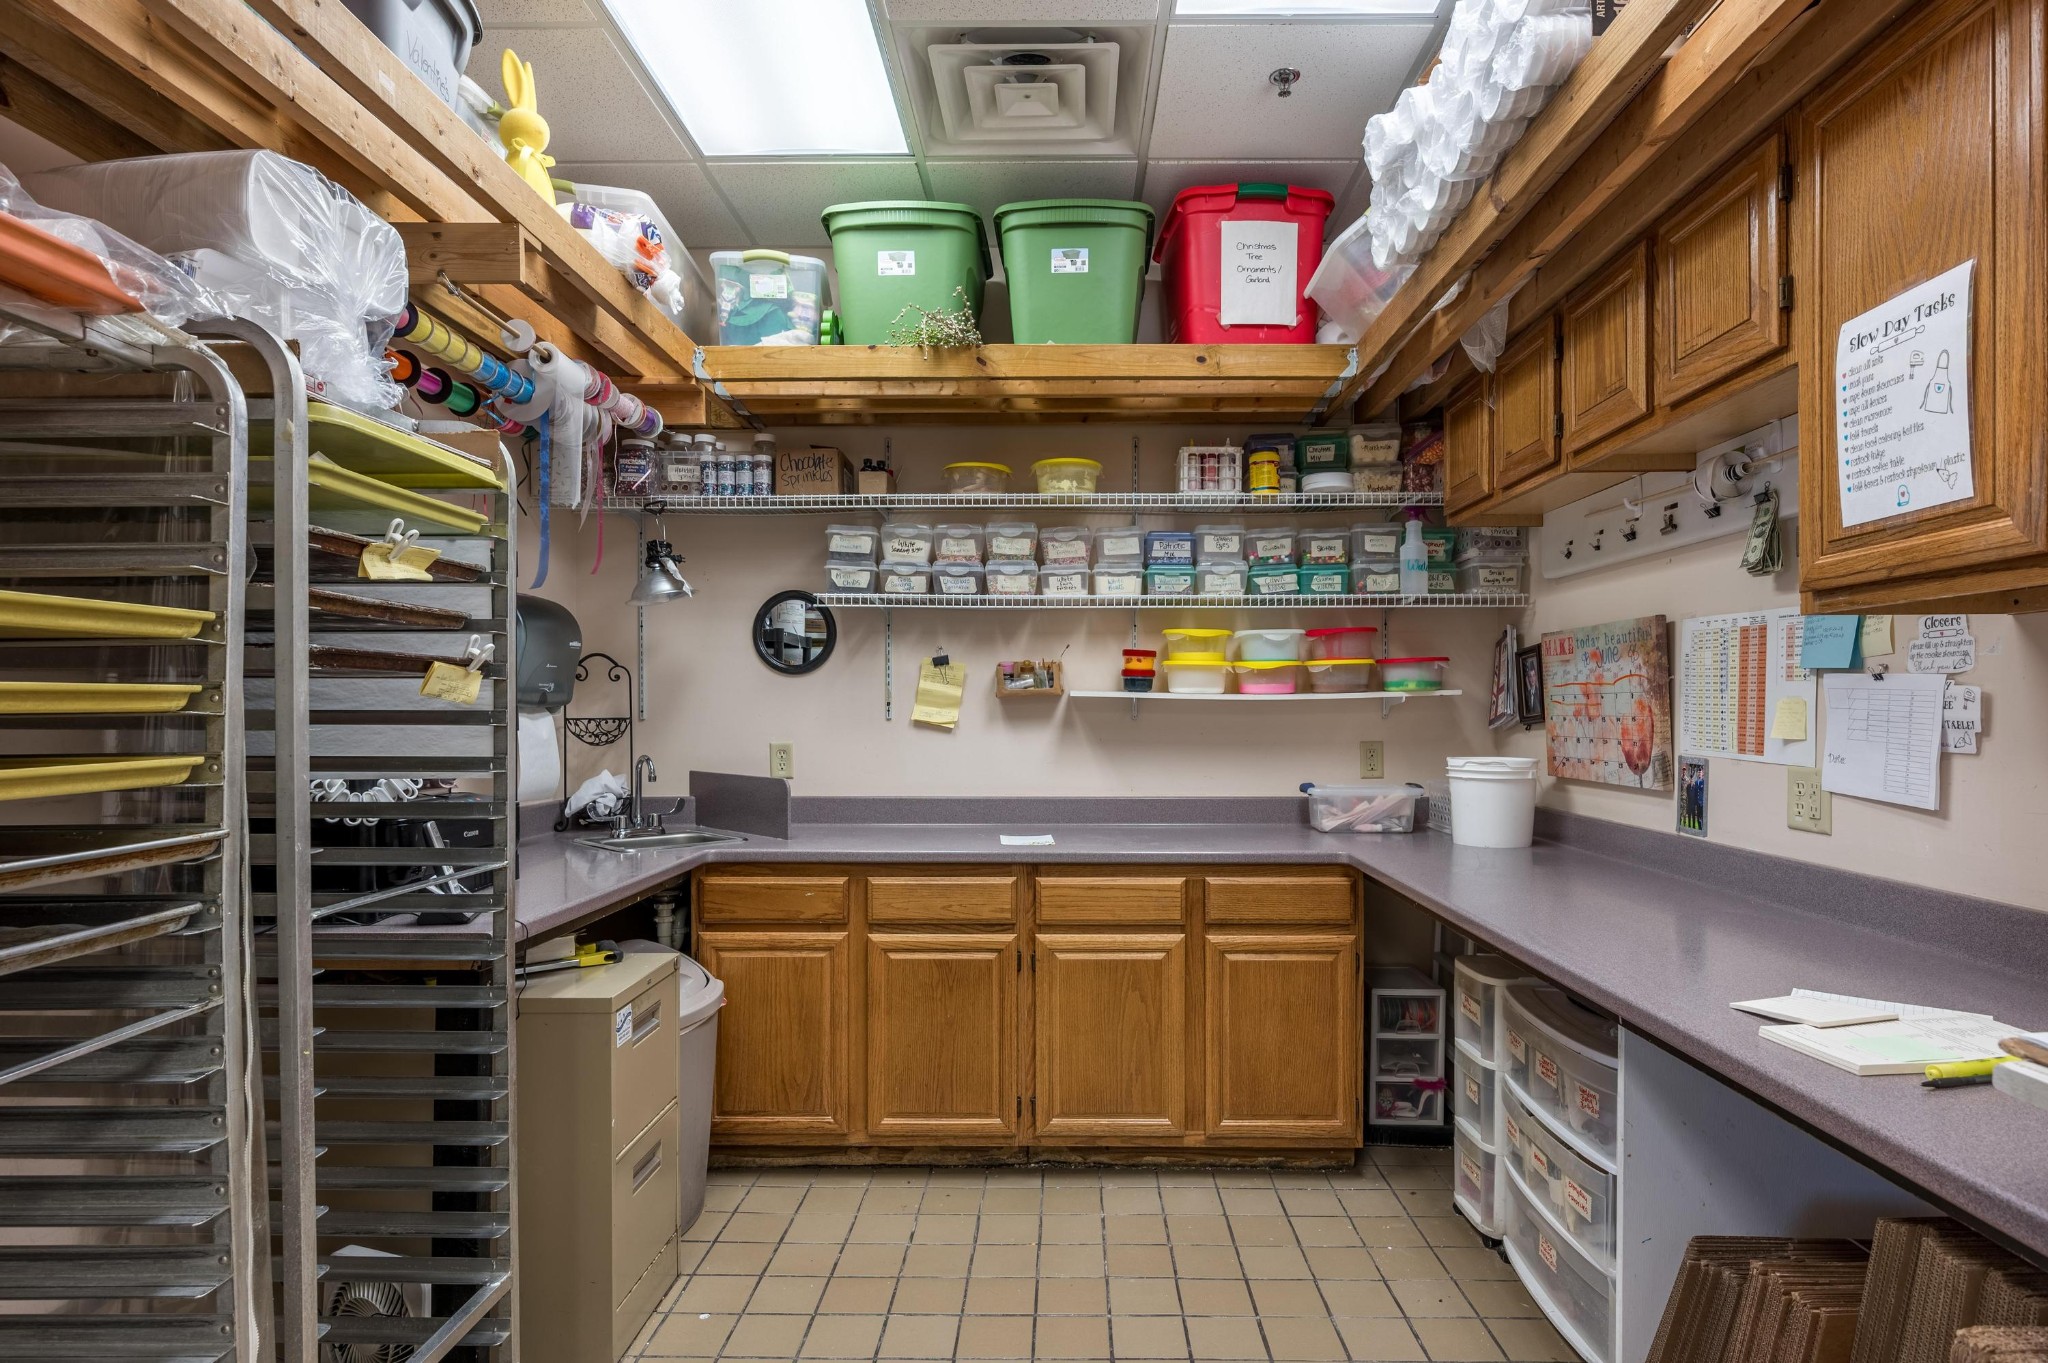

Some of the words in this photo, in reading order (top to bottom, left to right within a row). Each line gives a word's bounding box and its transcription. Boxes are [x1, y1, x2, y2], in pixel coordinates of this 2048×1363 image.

[406, 30, 449, 103] Valentine's
[1236, 241, 1277, 250] Christmas
[1246, 252, 1263, 260] Tree
[1246, 275, 1270, 283] Garland
[1850, 328, 1879, 353] Slow
[1882, 315, 1911, 338] Day
[1913, 293, 1955, 322] Tasks
[780, 452, 833, 472] Chocolate
[1924, 615, 1962, 630] Closers
[1544, 636, 1574, 656] MAKE
[1576, 634, 1600, 650] today
[1604, 626, 1652, 645] beautiful
[1596, 645, 1621, 668] June
[1942, 720, 1975, 730] TABLE!
[463, 829, 479, 838] Canon
